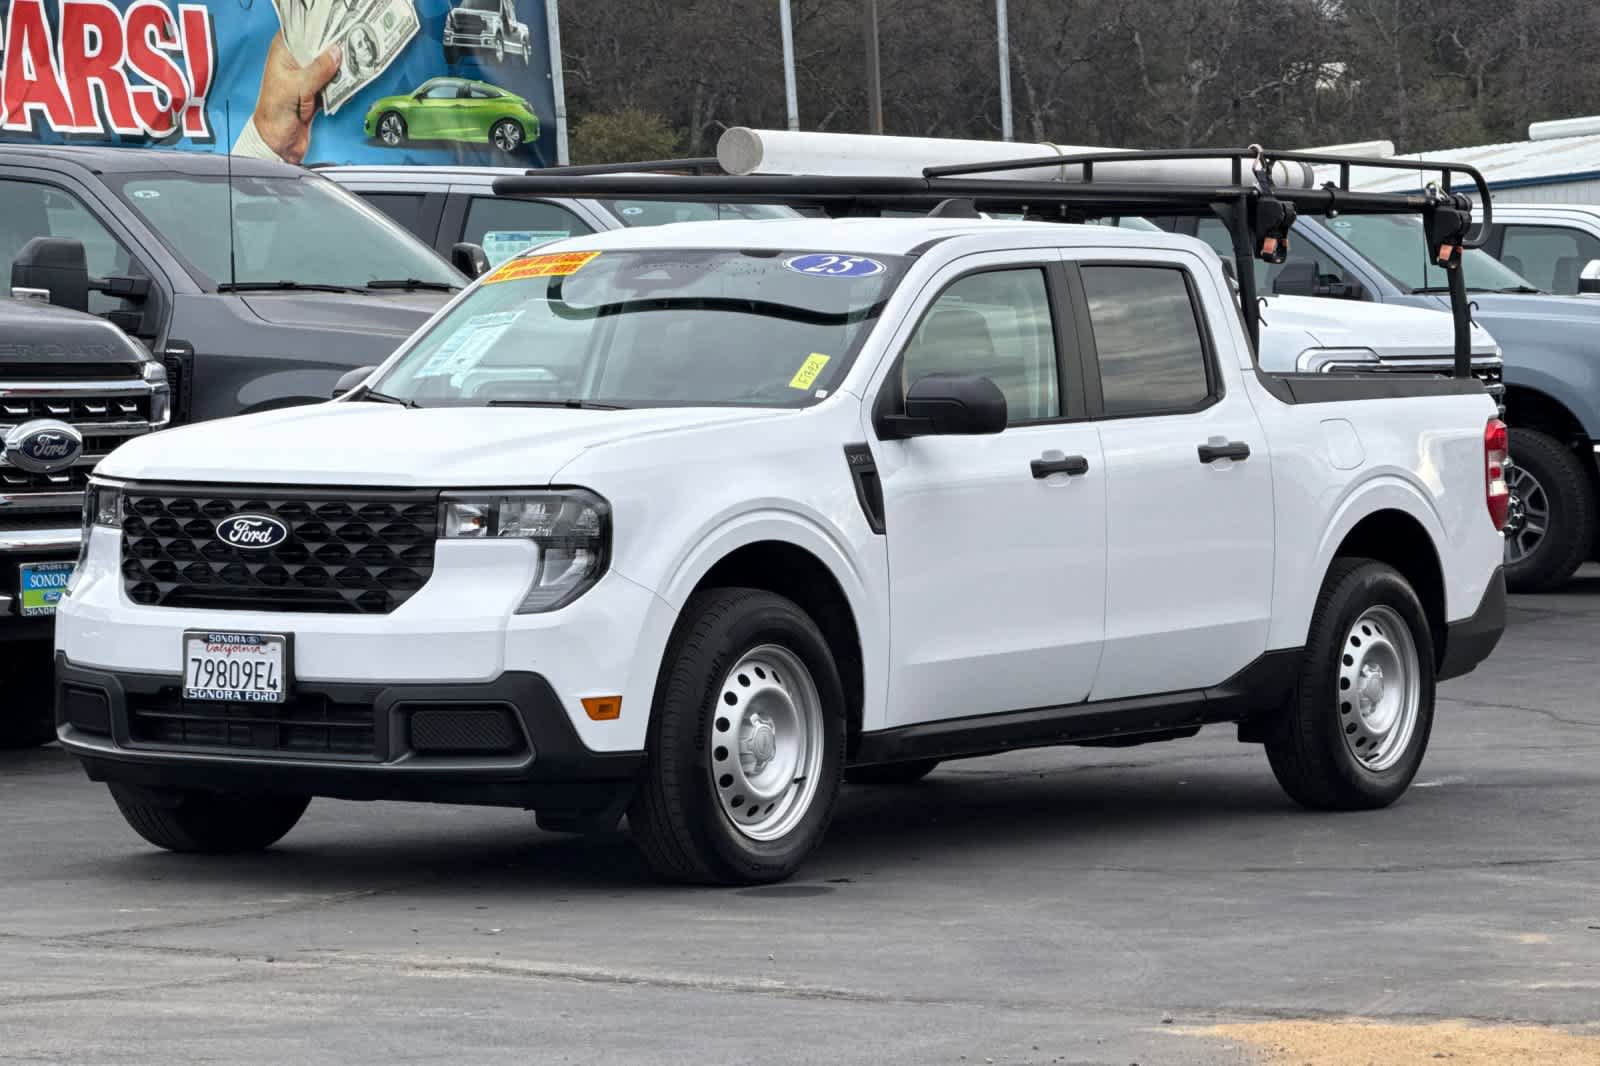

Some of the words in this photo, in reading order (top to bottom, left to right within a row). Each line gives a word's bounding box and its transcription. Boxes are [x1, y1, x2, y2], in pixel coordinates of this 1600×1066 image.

[0, 0, 212, 138] ARS!
[803, 256, 864, 273] 25
[32, 434, 69, 457] Ford
[229, 519, 273, 543] Ford
[30, 574, 67, 588] SONOR
[208, 633, 246, 643] SONORA
[205, 642, 267, 657] California
[190, 657, 278, 691] 79809E4
[188, 688, 241, 700] SONORA
[245, 691, 278, 701] FORD
